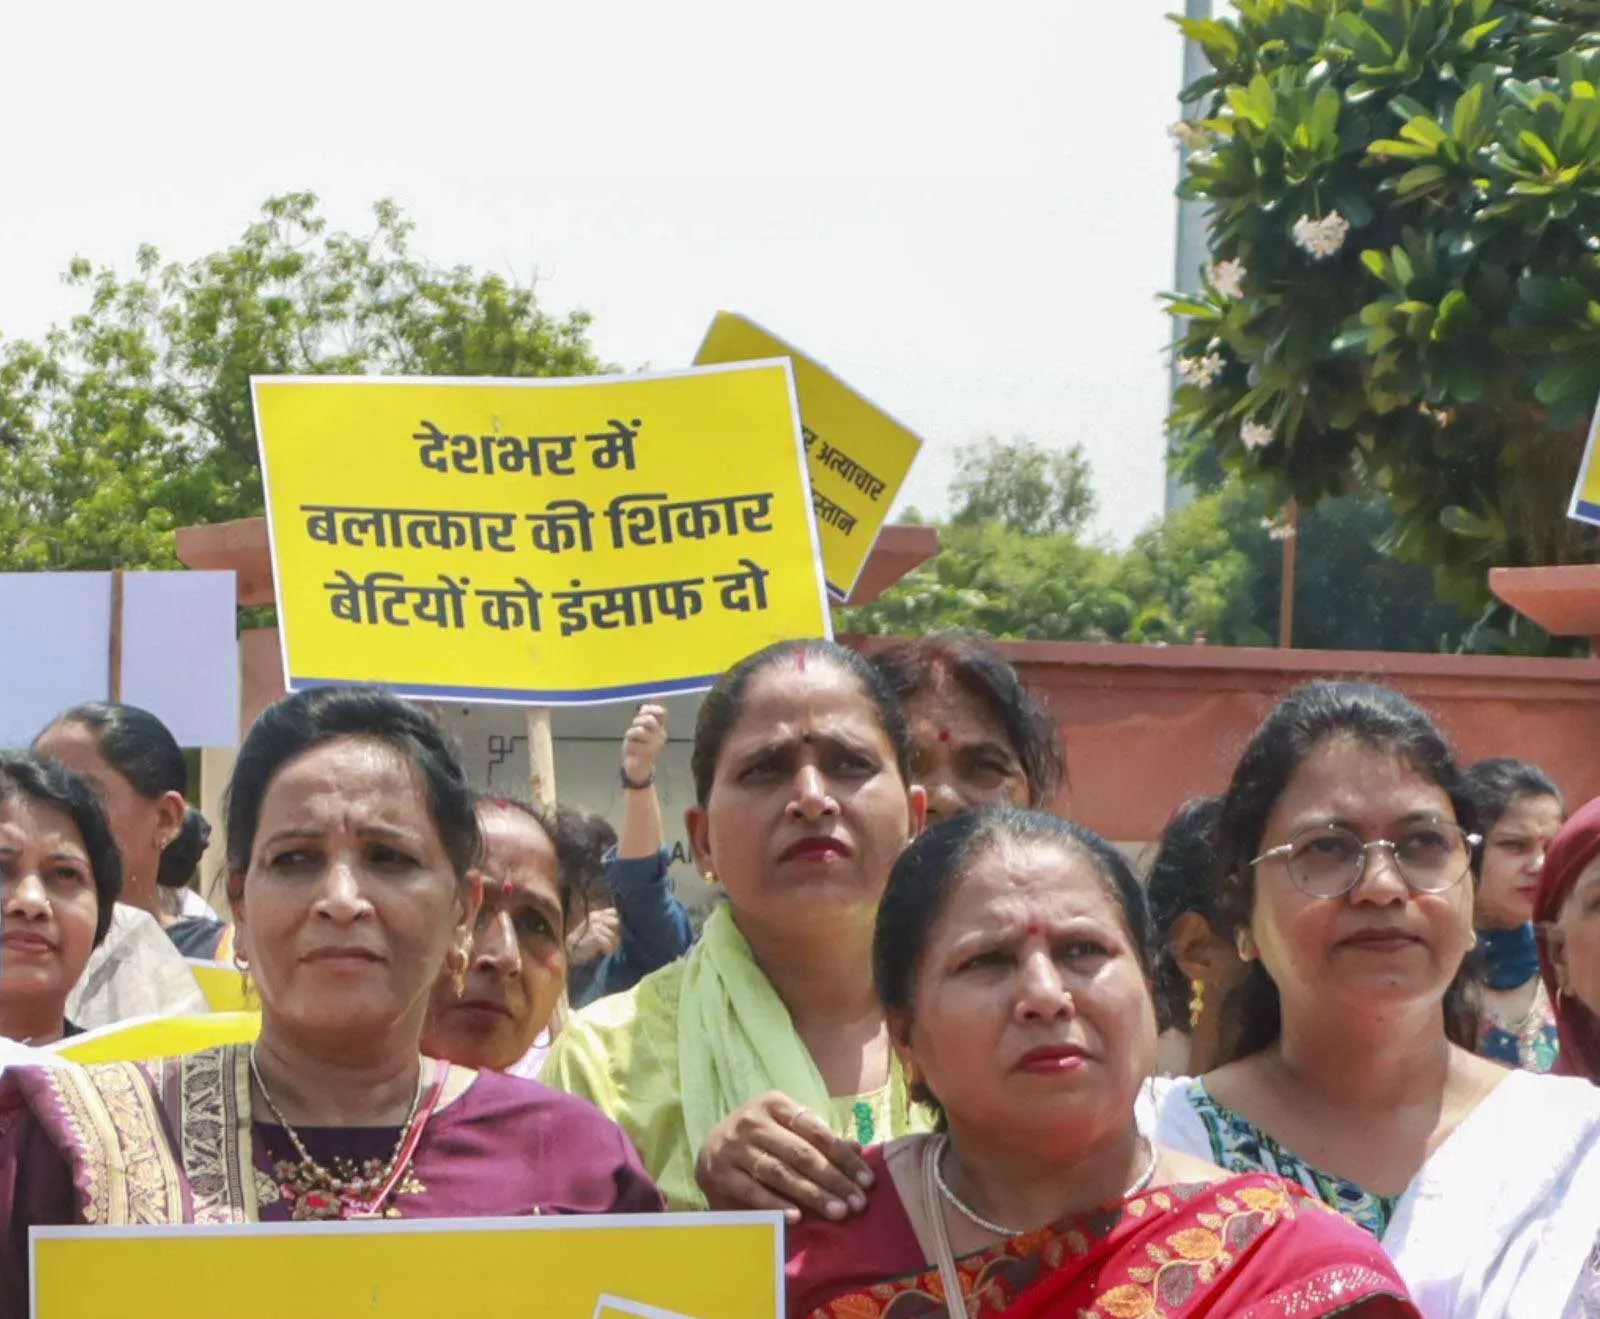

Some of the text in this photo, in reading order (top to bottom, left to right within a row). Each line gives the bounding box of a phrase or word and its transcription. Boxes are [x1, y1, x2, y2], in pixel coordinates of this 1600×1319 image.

[413, 419, 641, 476] देशभर में
[816, 441, 886, 501] अत्याचार
[300, 493, 773, 553] बलात्कार की शिकार
[324, 559, 769, 636] बेटियों को इंसाफ दो
